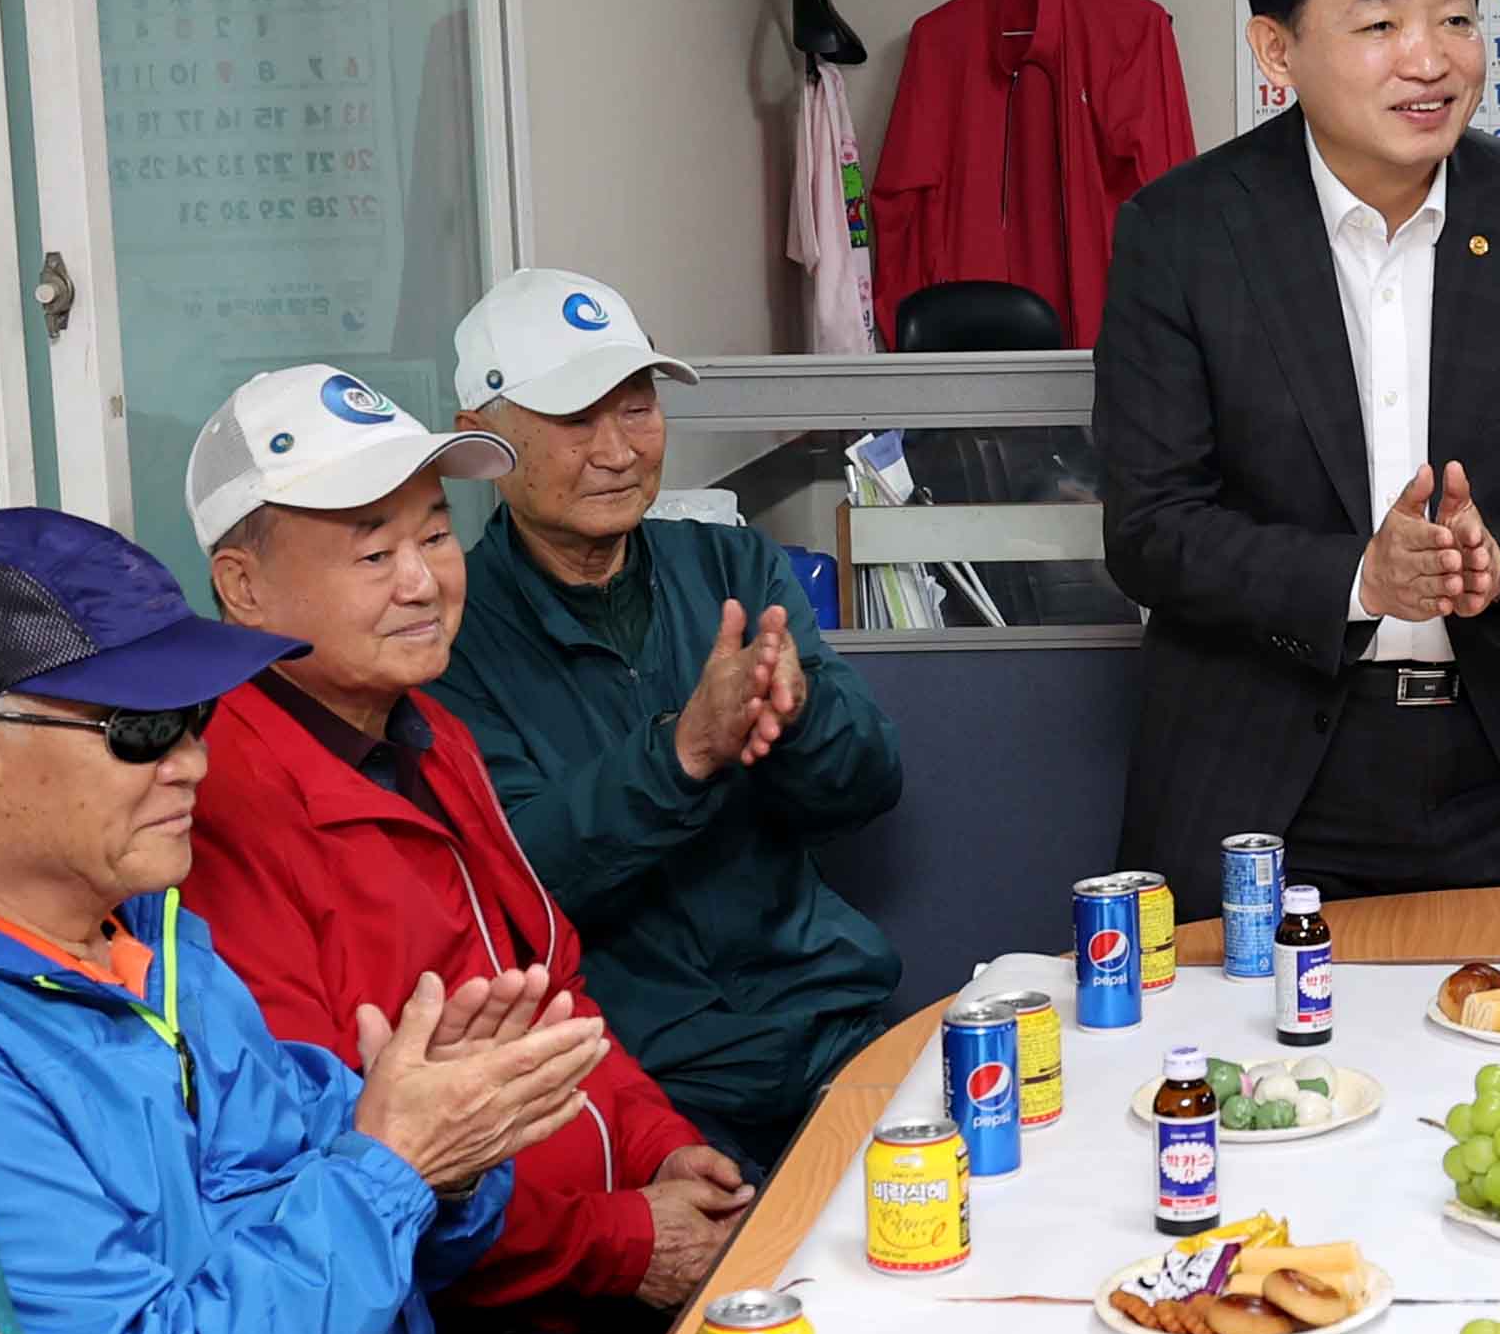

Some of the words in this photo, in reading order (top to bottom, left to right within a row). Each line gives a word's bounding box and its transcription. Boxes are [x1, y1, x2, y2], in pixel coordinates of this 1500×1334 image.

[1259, 85, 1286, 106] 13
[1093, 973, 1128, 987] pepsi
[973, 1112, 1012, 1129] pepsi
[1166, 1154, 1211, 1168] 박카스
[872, 1178, 949, 1206] 비락식혜
